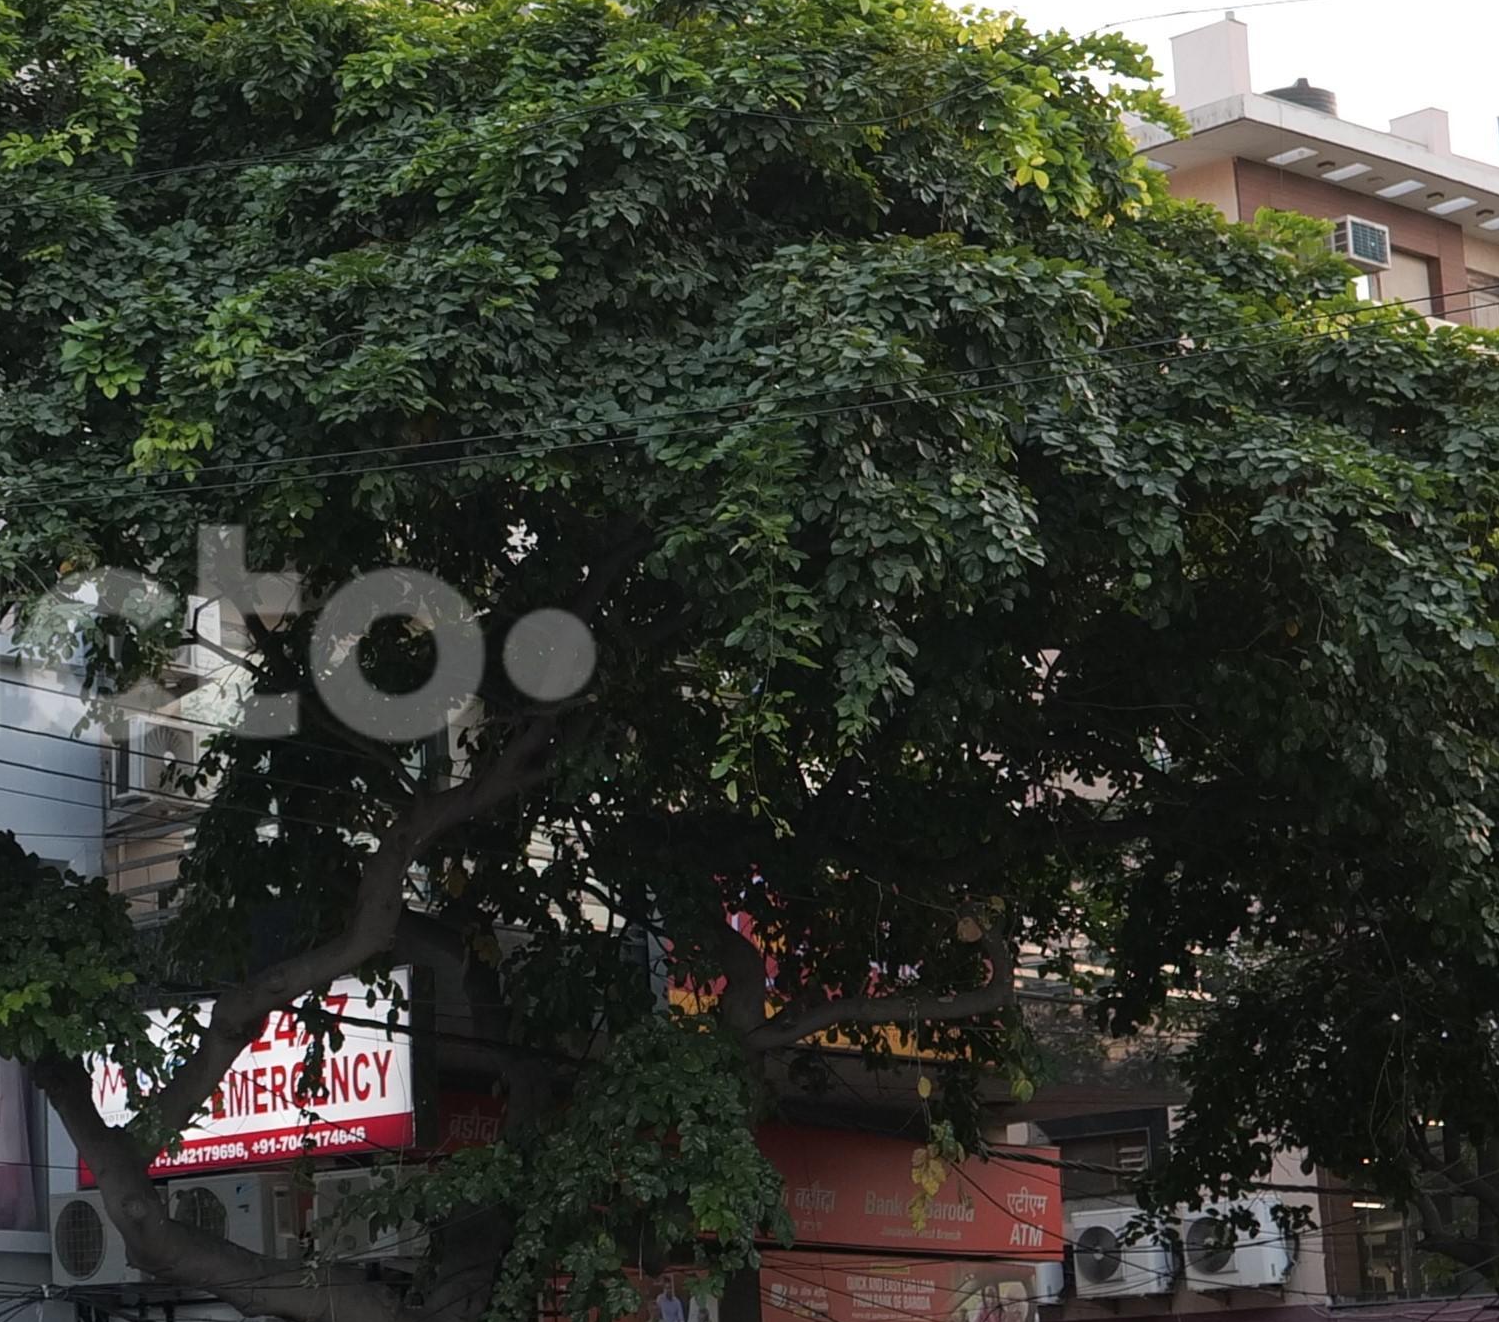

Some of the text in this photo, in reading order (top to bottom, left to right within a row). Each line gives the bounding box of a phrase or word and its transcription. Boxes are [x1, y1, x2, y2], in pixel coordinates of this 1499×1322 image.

[865, 1190, 903, 1216] Bank
[1006, 1186, 1048, 1216] एटीएम
[1010, 1223, 1043, 1247] ATM
